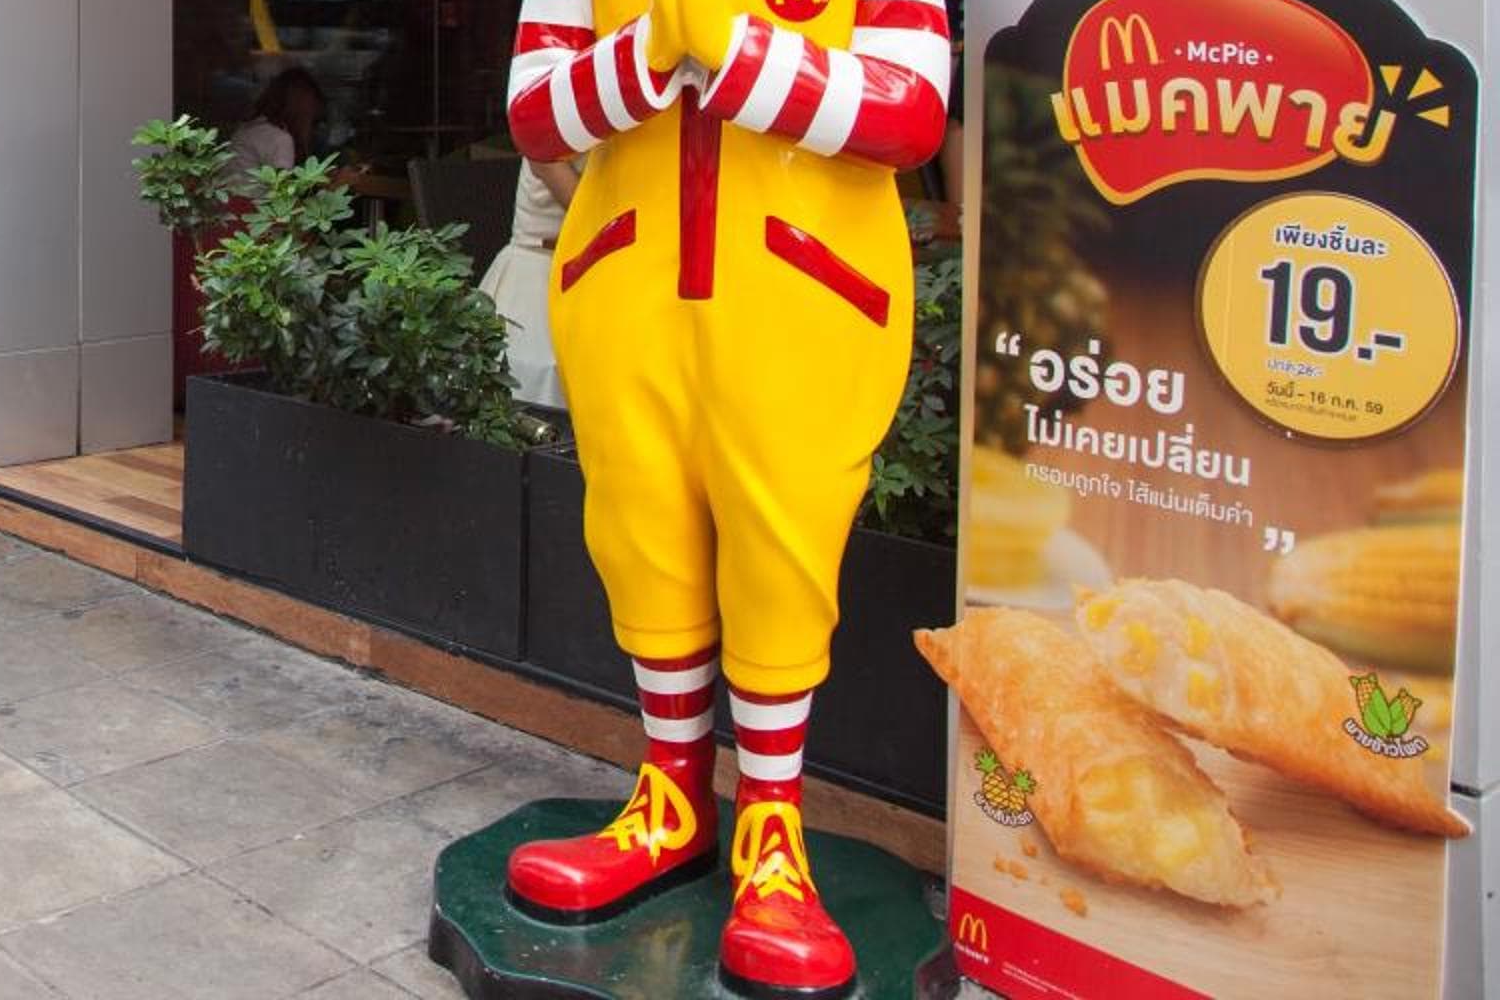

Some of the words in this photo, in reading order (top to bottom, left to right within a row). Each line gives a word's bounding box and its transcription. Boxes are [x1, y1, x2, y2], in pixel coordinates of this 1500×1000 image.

[1186, 40, 1260, 66] McPie
[1051, 76, 1396, 166] แมคพาย
[1275, 224, 1385, 255] เพียงชิ้นละ
[1261, 261, 1401, 360] 19.-
[1365, 401, 1384, 415] 59
[1024, 403, 1251, 487] ไม่เคยเปลี่ยน
[1026, 463, 1122, 498] กรอบถูกใจ
[1128, 479, 1253, 528] ไส้แน่นเต็มคำ
